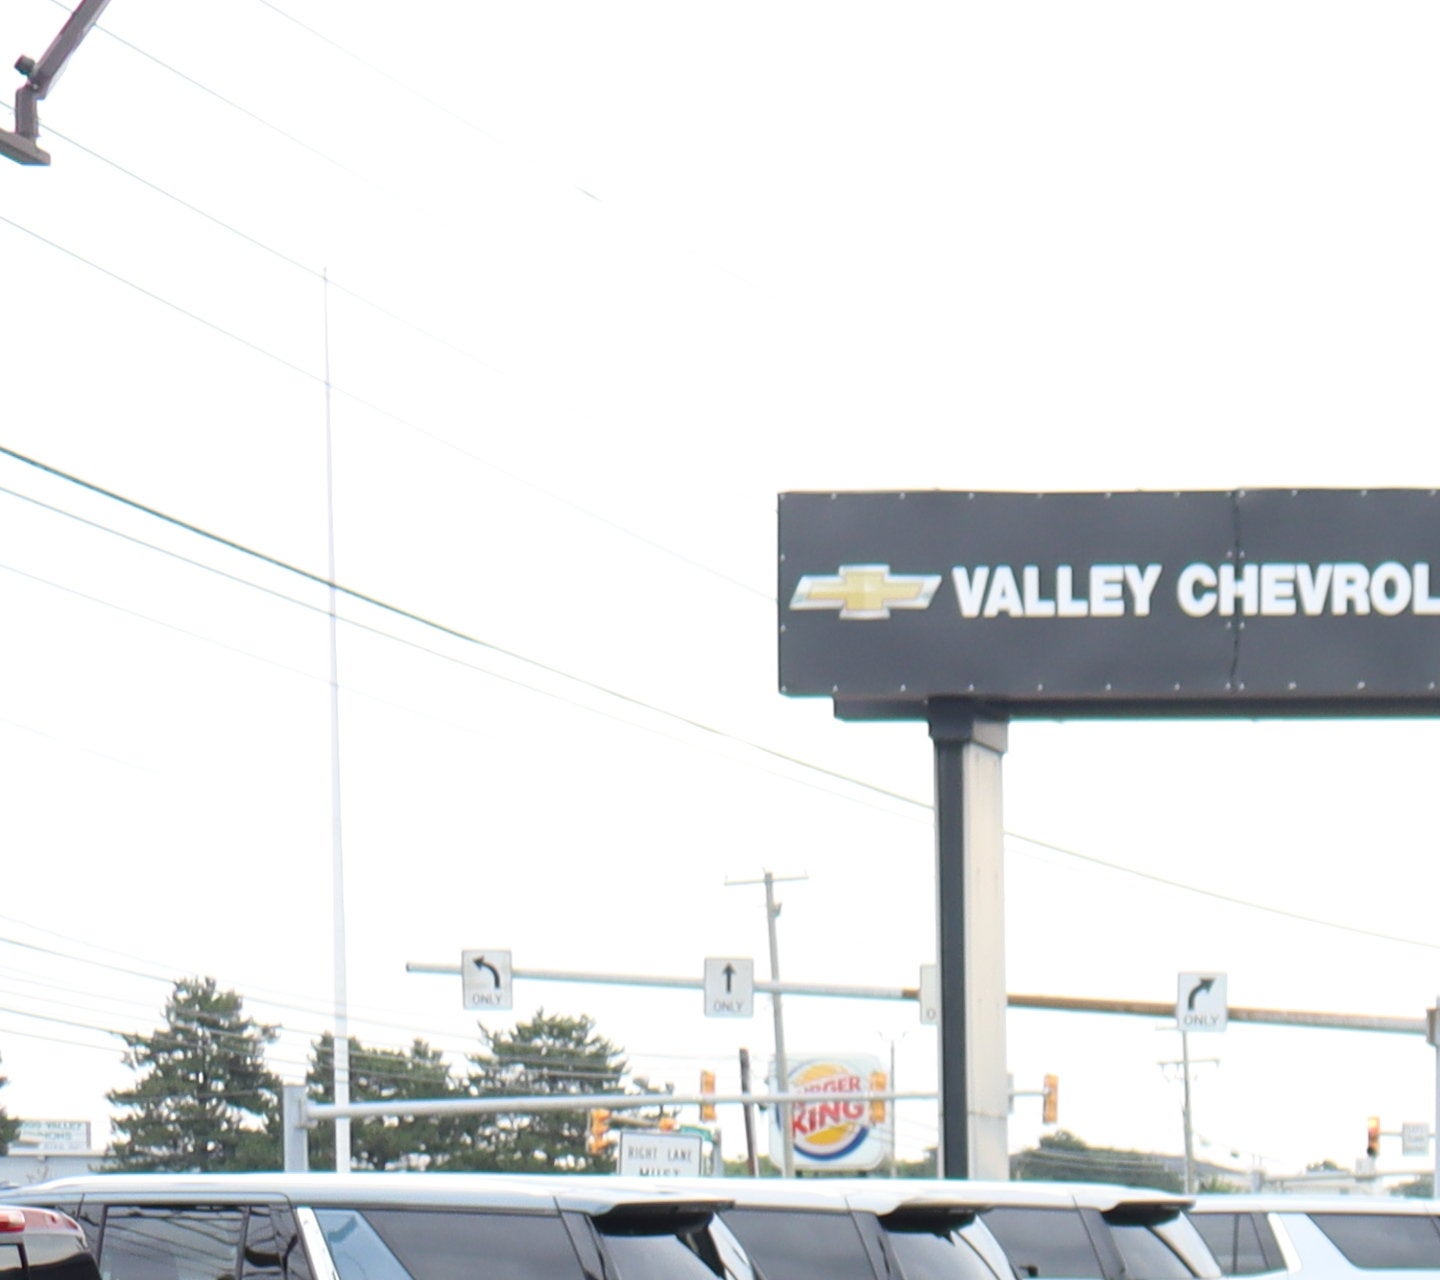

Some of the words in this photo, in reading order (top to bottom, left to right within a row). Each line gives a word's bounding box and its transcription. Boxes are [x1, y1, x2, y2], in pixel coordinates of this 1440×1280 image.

[952, 565, 1162, 617] VALLEY
[472, 993, 502, 1005] ONLY
[713, 1000, 743, 1012] ONLY
[1184, 1014, 1220, 1027] ONLY
[791, 1100, 864, 1138] KING
[628, 1145, 658, 1159] RIGHT
[667, 1147, 693, 1162] LANE
